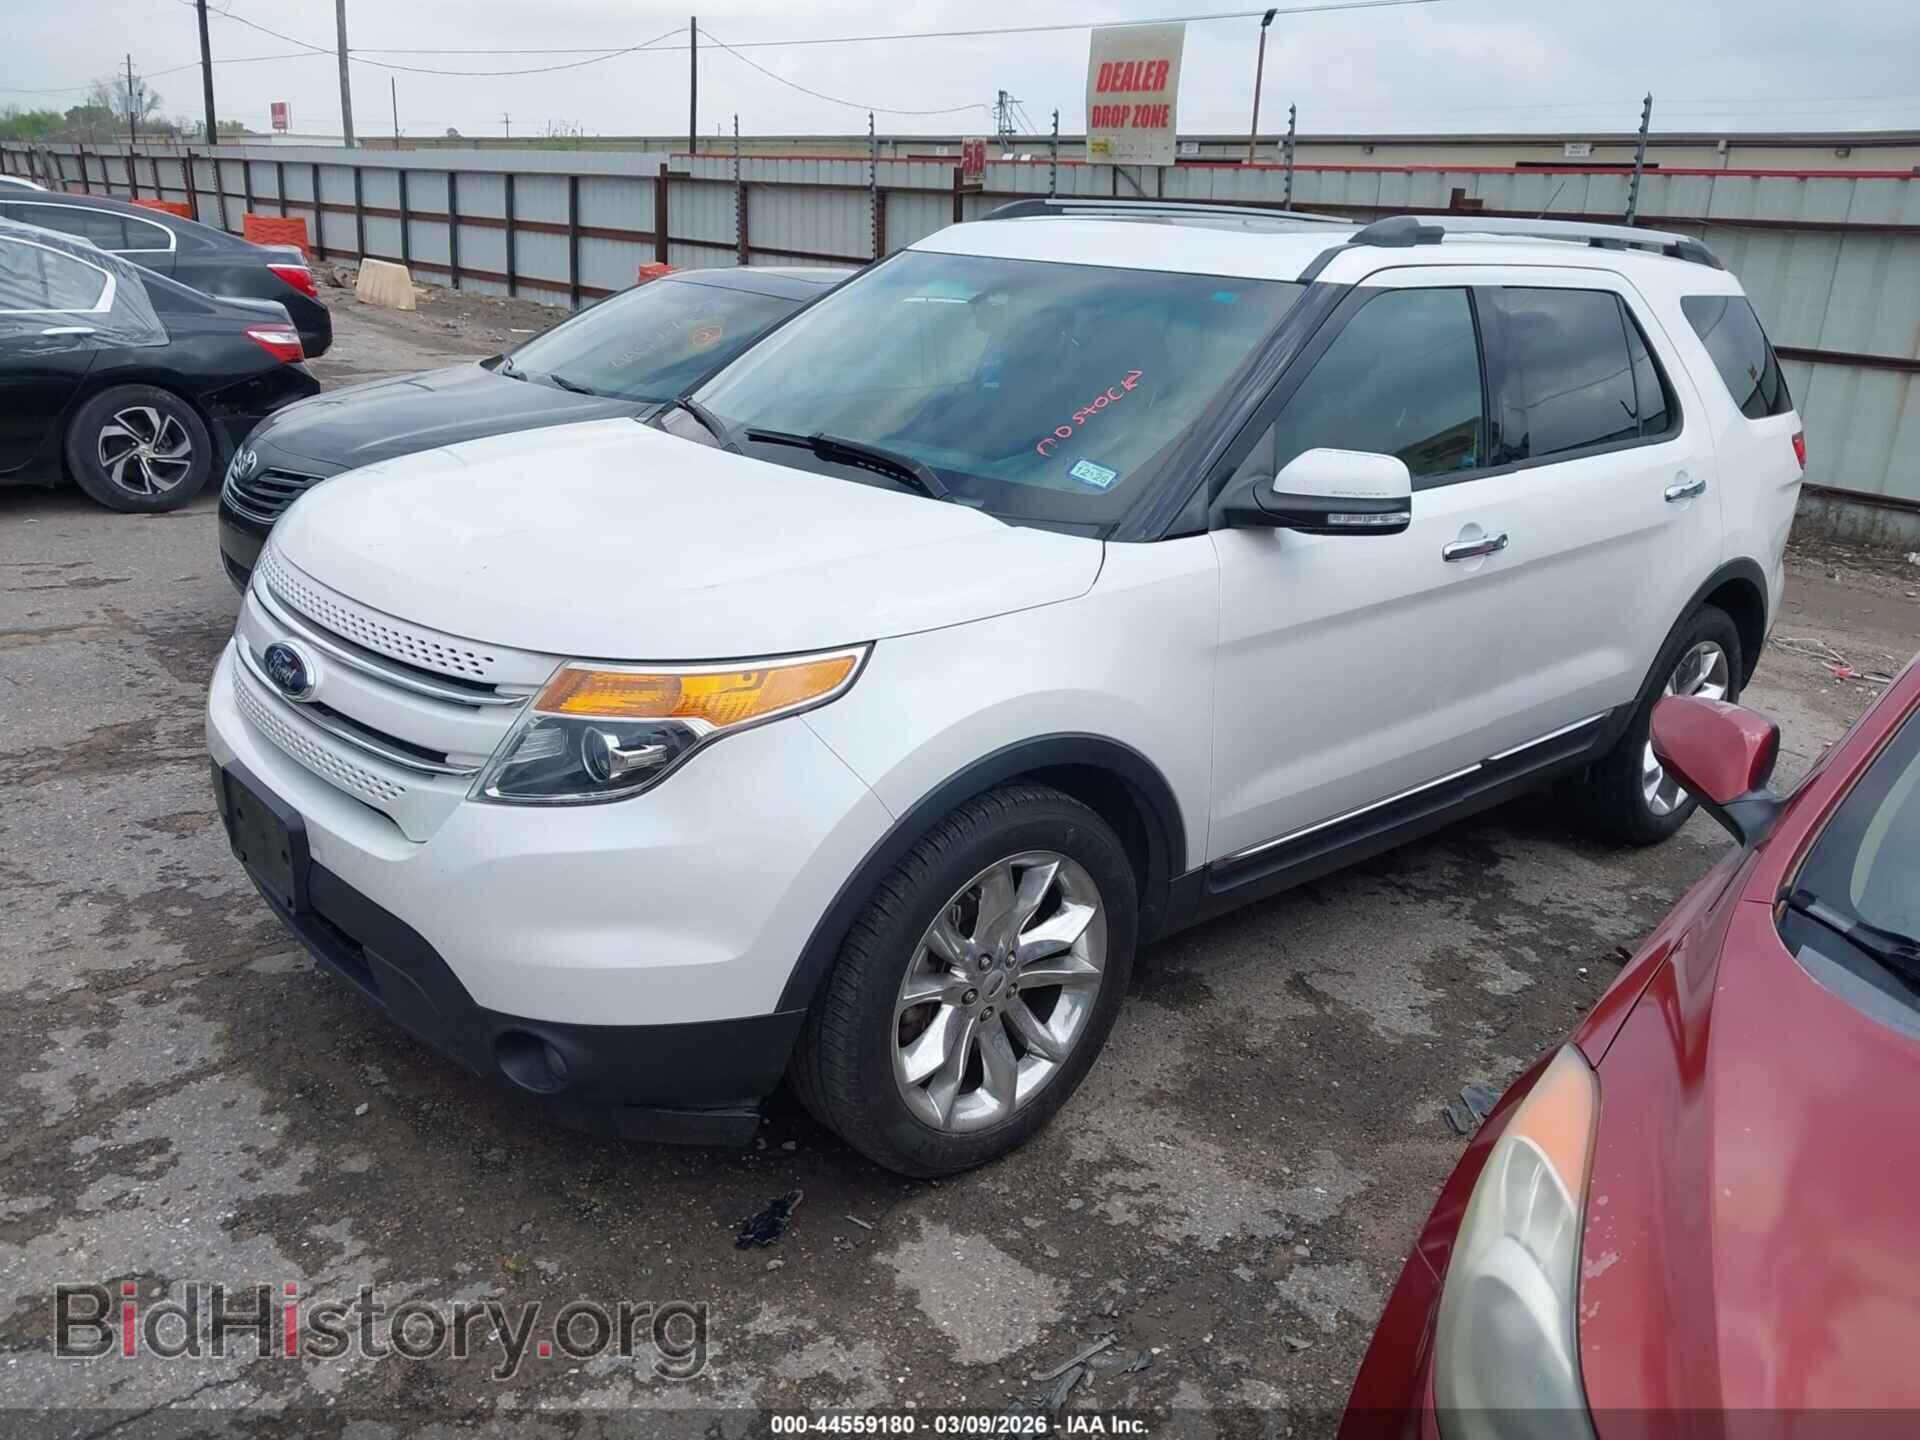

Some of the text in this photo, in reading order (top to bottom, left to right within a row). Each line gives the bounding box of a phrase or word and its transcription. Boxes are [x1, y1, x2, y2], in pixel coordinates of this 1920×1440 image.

[1096, 59, 1170, 93] DEALER
[1091, 104, 1171, 129] DROP ZONE
[268, 648, 298, 686] Ford
